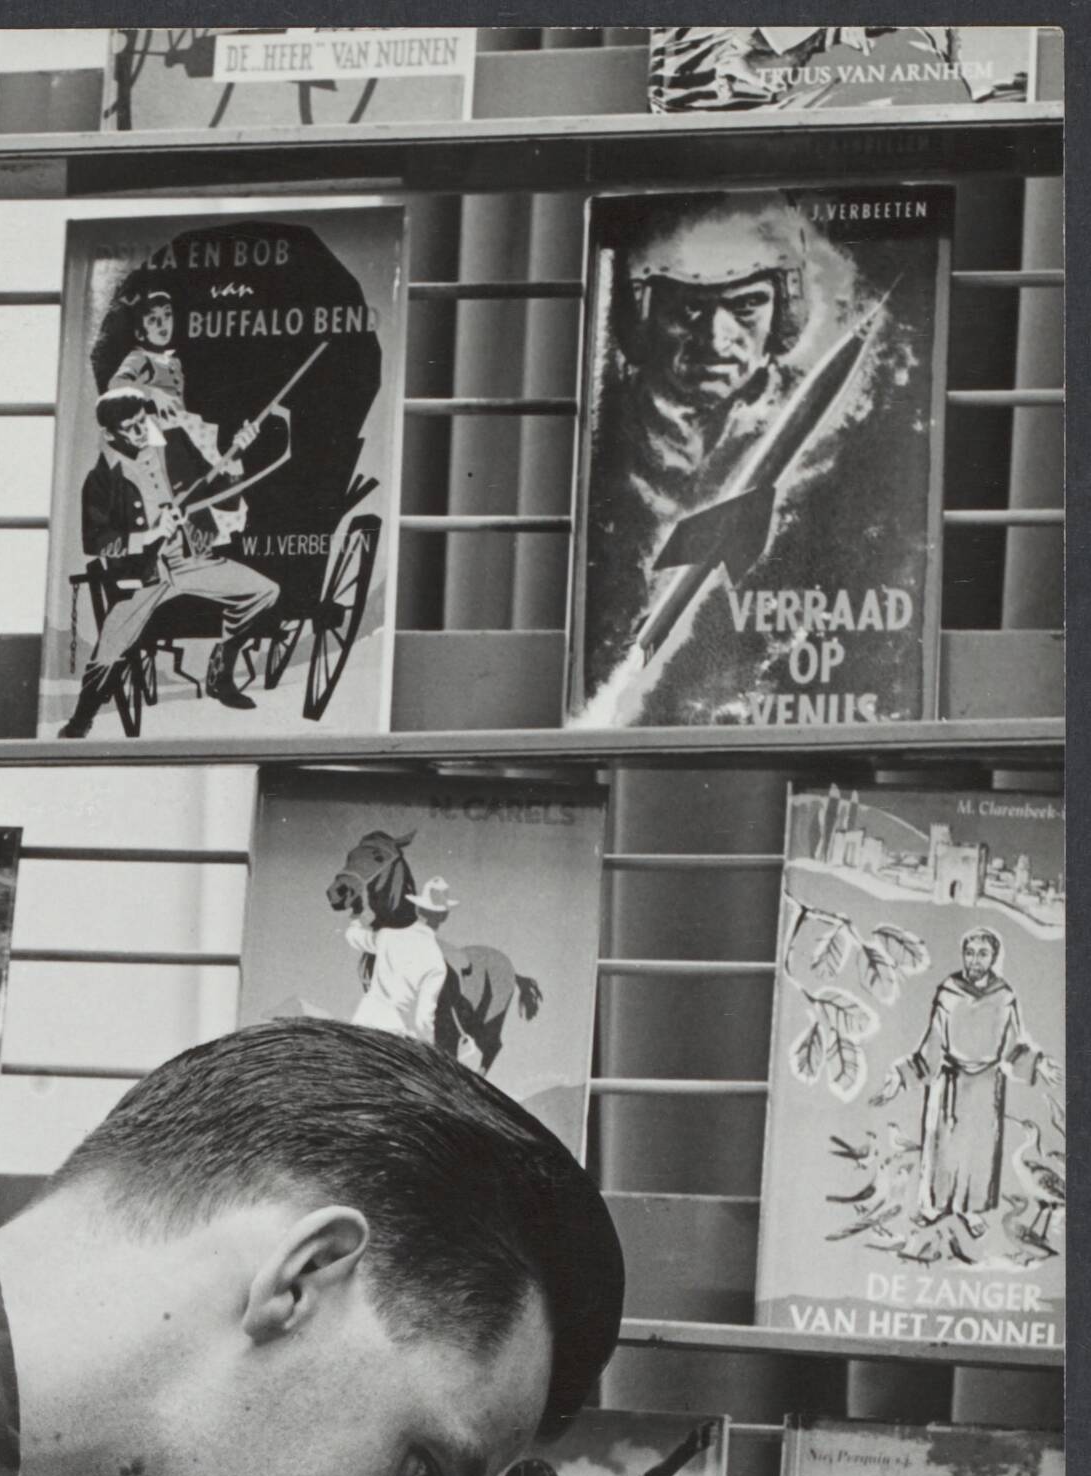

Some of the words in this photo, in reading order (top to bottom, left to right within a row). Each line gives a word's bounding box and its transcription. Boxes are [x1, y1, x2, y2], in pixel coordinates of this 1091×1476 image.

[225, 44, 253, 73] DE
[331, 40, 371, 69] VAN
[375, 36, 459, 68] NUENEN
[837, 64, 886, 84] VAN
[890, 60, 994, 82] ARNHEM
[188, 242, 220, 269] EN
[233, 239, 290, 268] BOB
[211, 281, 255, 300] van
[187, 307, 304, 339] BUFFALO
[730, 588, 914, 632] VERRAAD
[789, 640, 846, 685] OP
[868, 1272, 908, 1302] DE
[915, 1276, 1043, 1312] ZANGER
[789, 1304, 857, 1334] VAN
[868, 1309, 928, 1338] HET
